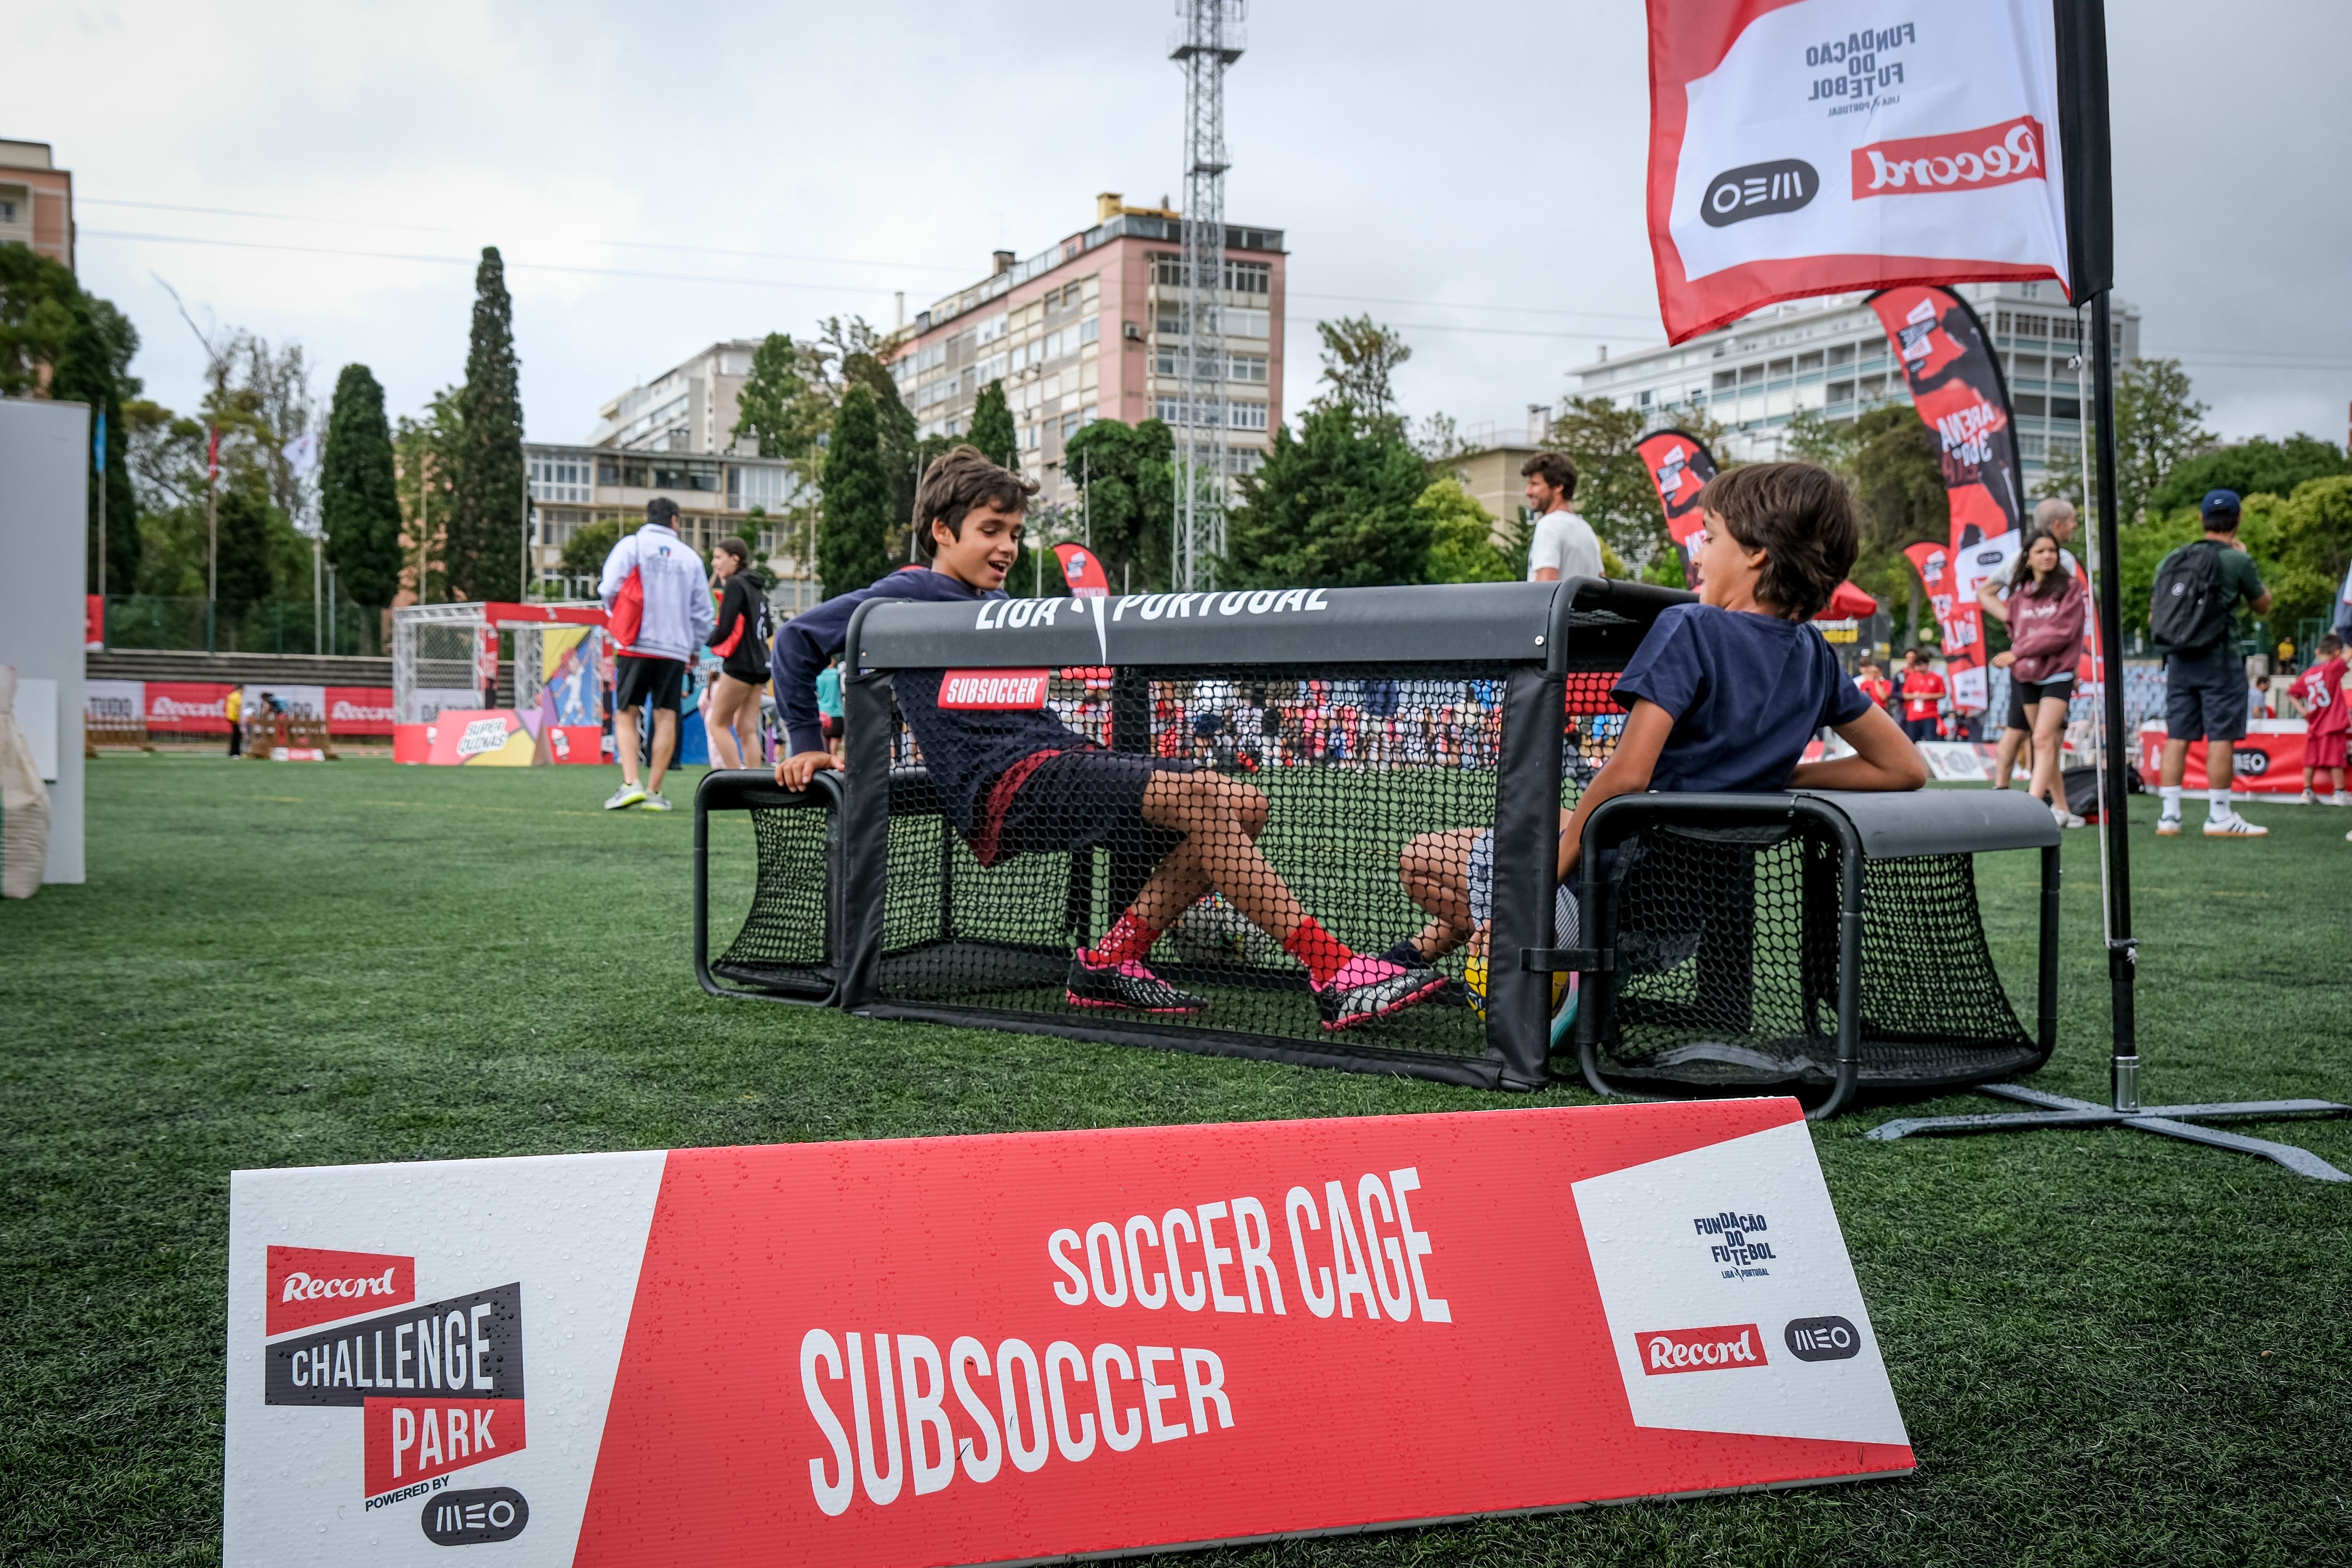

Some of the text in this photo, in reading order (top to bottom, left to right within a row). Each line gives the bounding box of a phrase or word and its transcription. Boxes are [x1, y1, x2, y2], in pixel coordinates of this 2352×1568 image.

[975, 597, 1066, 630] LIGA
[152, 695, 227, 718] Record
[332, 700, 398, 720] Recor
[1694, 1211, 1767, 1235] FUNDAÇÃO
[1724, 1230, 1745, 1247] DO
[1048, 1166, 1453, 1323] SOCCER CAGE
[1711, 1242, 1776, 1266] FUTEBOL
[282, 1267, 396, 1303] Record
[1721, 1267, 1770, 1279] LIGA PORTUGAL
[292, 1302, 494, 1391] CHALLENGE
[1648, 1326, 1850, 1369] Record MEO
[800, 1328, 1235, 1517] SUBSOCCER
[392, 1408, 496, 1479] PARK
[365, 1475, 450, 1512] POWERED BY
[436, 1500, 515, 1532] MEO
